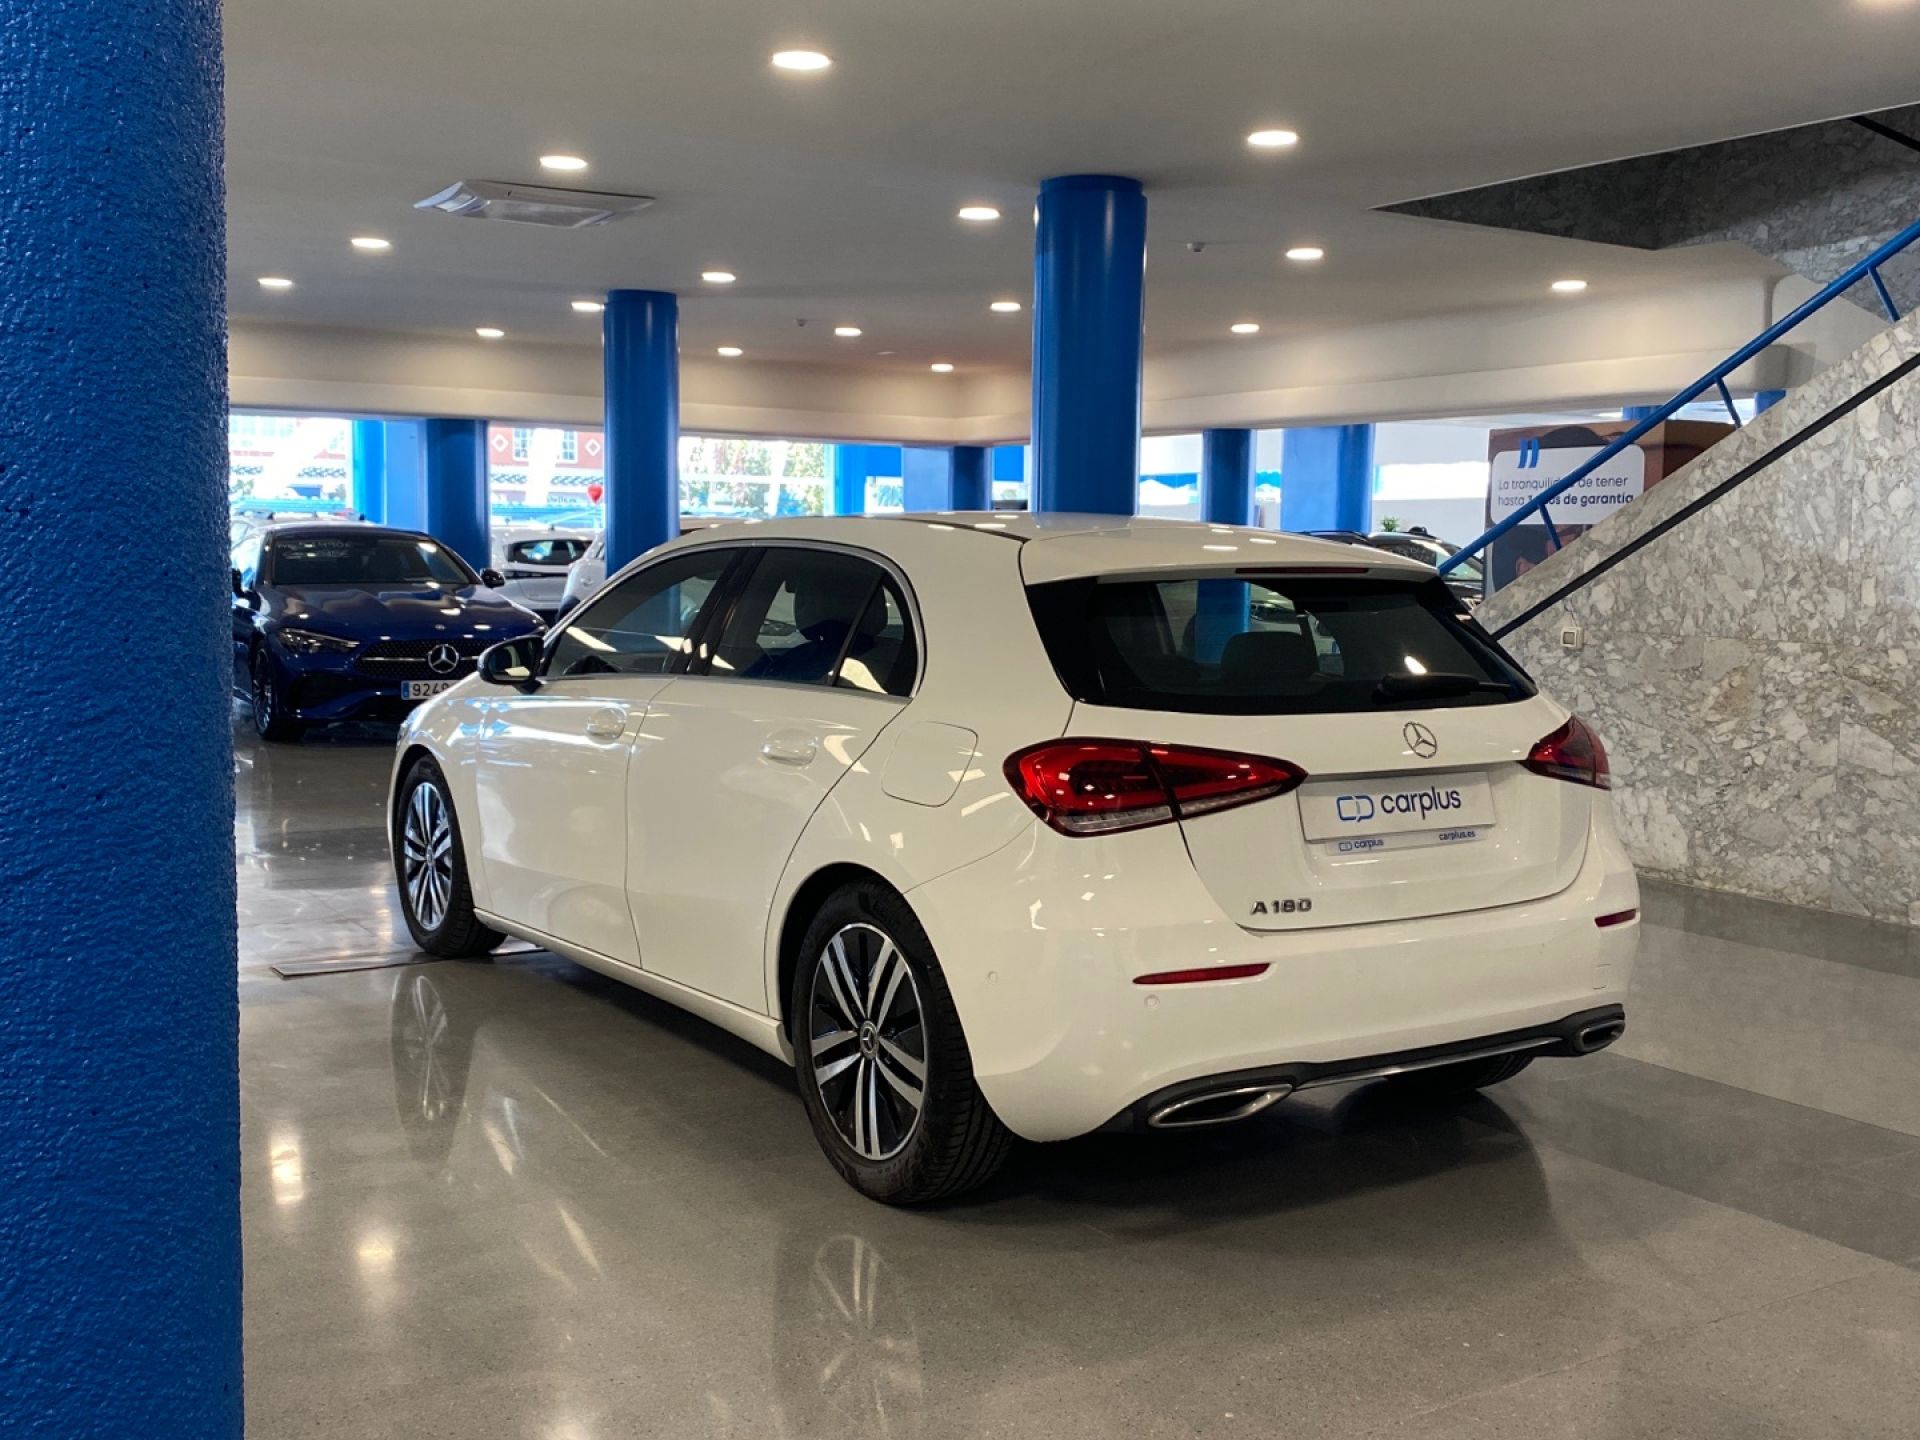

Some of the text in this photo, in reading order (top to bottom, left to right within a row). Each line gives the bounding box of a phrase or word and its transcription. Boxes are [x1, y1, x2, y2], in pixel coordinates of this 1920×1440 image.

[1498, 479, 1509, 491] La
[1511, 476, 1575, 492] tranquili
[1595, 476, 1628, 488] tener
[1498, 494, 1525, 507] hasta
[1563, 494, 1578, 505] de
[1580, 491, 1634, 507] garantía
[1380, 785, 1462, 820] carplus
[1438, 829, 1476, 841] carplus.es
[1354, 838, 1385, 851] carplus
[1250, 898, 1312, 915] A 180
